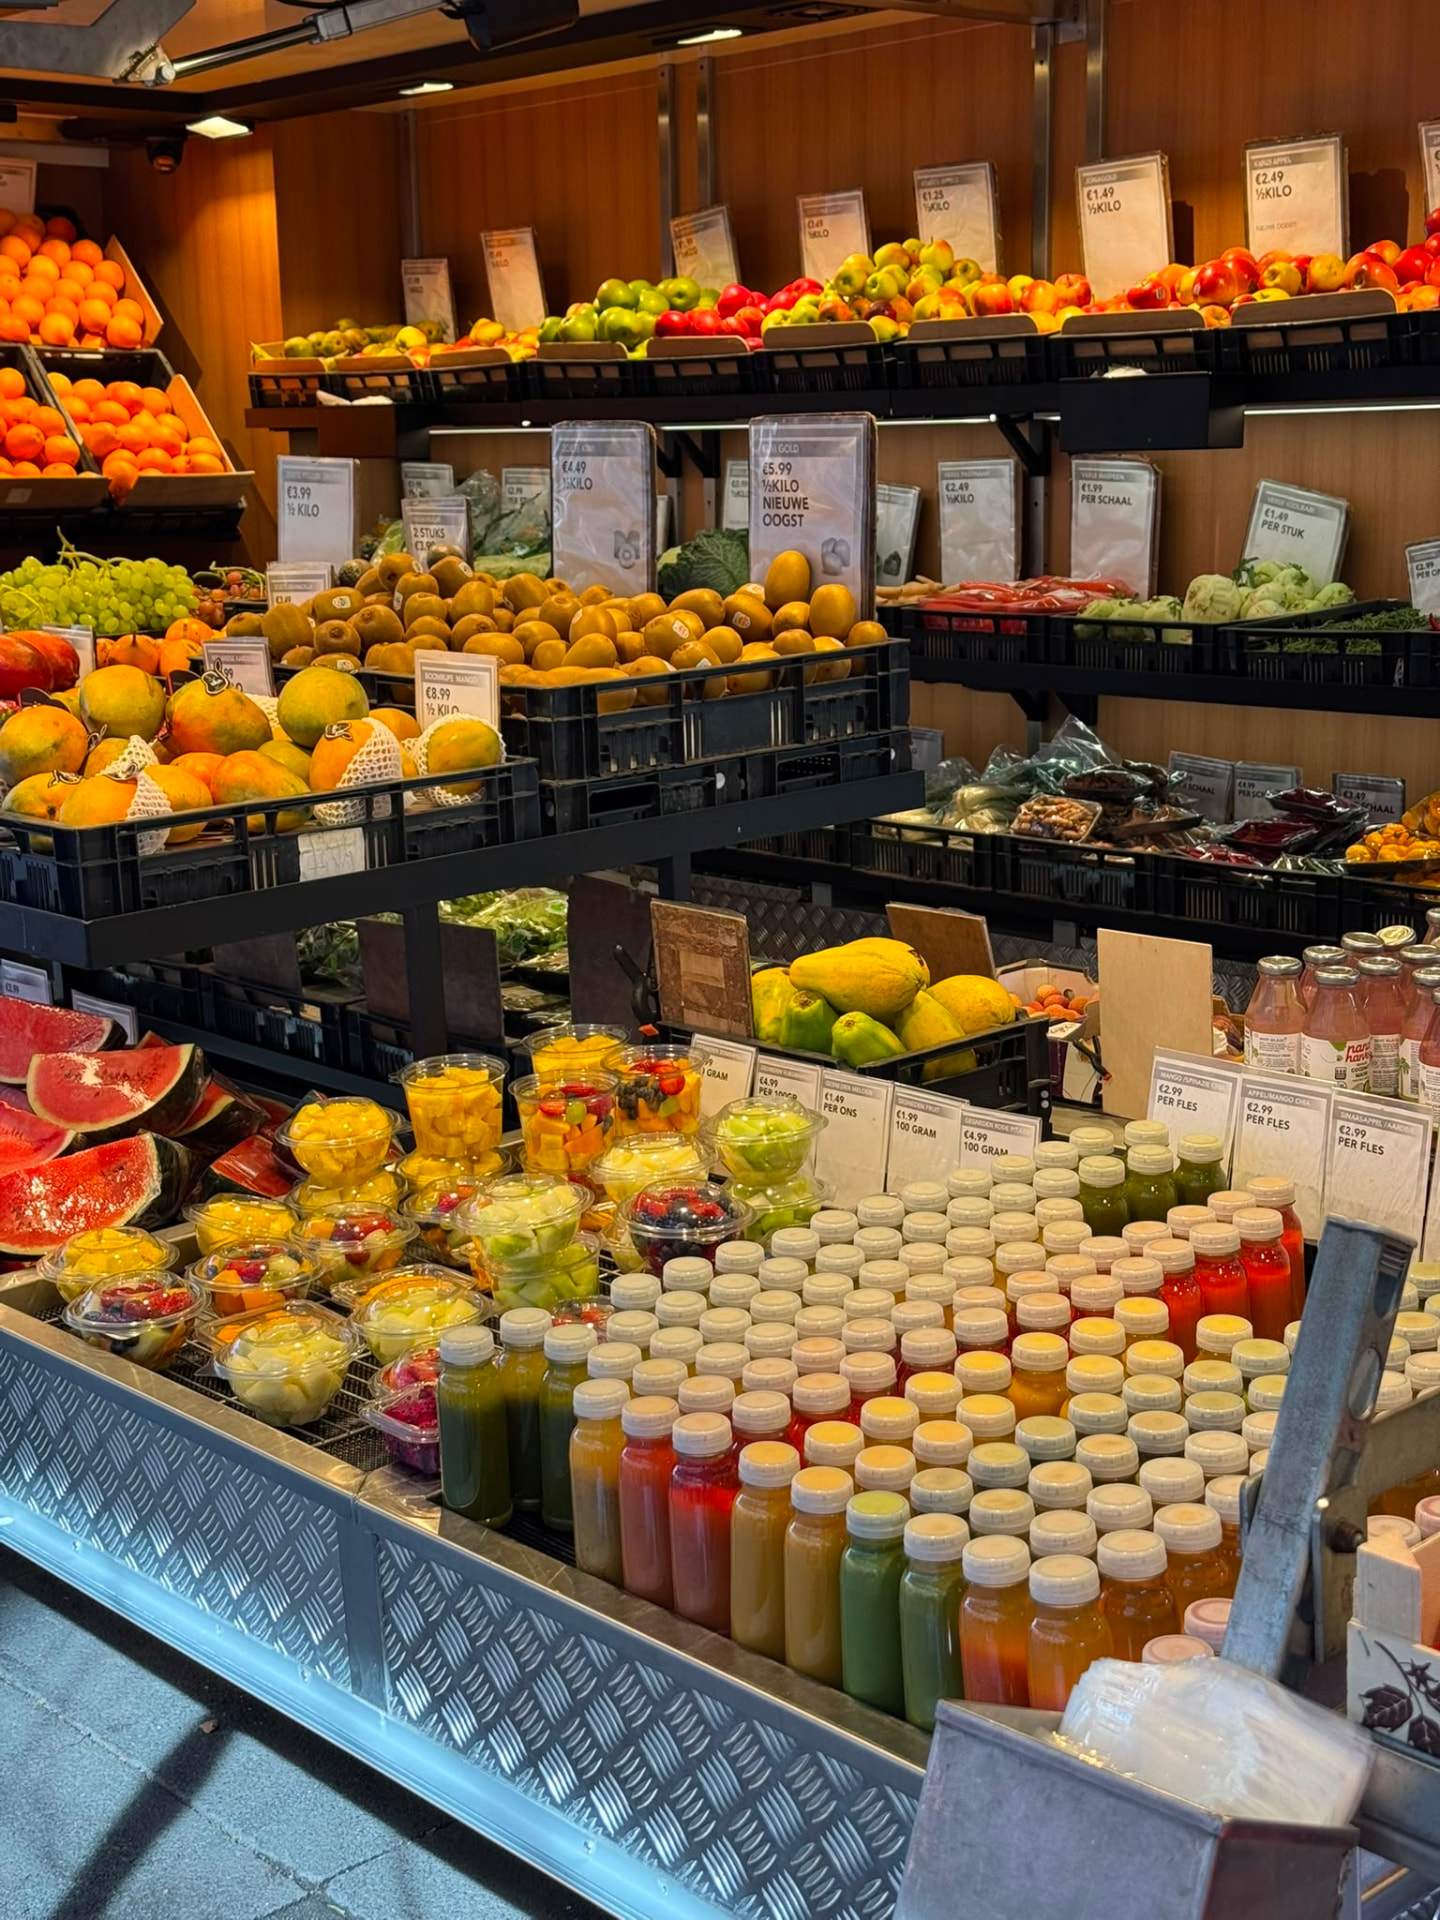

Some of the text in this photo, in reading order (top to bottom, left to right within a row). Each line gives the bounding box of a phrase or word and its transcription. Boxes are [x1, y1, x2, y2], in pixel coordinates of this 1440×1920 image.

[1255, 170, 1285, 186] €2.49
[922, 189, 945, 202] €1.25
[1086, 186, 1115, 201] €1.49
[1255, 184, 1293, 201] ½KILO
[1087, 200, 1122, 216] ½KILO
[562, 460, 588, 474] €4.49
[762, 462, 793, 476] €5.99
[286, 485, 312, 500] €3.99
[762, 479, 800, 493] ½KILO
[945, 482, 970, 493] €2.49
[1081, 483, 1104, 493] €1.99
[762, 496, 810, 511] NIEUWE
[1080, 494, 1133, 506] PER SCHAAL
[297, 503, 320, 518] KILO
[1264, 507, 1290, 523] €1.49
[762, 513, 805, 528] OOGST
[412, 527, 446, 539] 2 STUKS
[1260, 519, 1306, 540] PER STUK
[1416, 570, 1431, 580] PER
[425, 686, 451, 701] €8.99
[1188, 783, 1216, 796] SCHAAL
[1238, 781, 1256, 790] €4.99
[1237, 789, 1252, 798] PER
[706, 1068, 729, 1082] GRAM
[759, 1075, 780, 1089] €4.99
[758, 1086, 773, 1098] PER
[824, 1091, 846, 1105] €1.49
[1158, 1083, 1183, 1098] €2.99
[823, 1102, 858, 1118] PER ONS
[1156, 1094, 1199, 1112] PER FLES
[1246, 1101, 1273, 1116] €2.99
[896, 1109, 919, 1123] €1.99
[1245, 1113, 1291, 1131] PER FLES
[895, 1119, 937, 1139] 100 GRAM
[963, 1129, 988, 1143] €4.99
[1338, 1124, 1367, 1139] €2.99
[963, 1141, 1009, 1157] 100 GRAM
[1337, 1136, 1385, 1156] PER FLES
